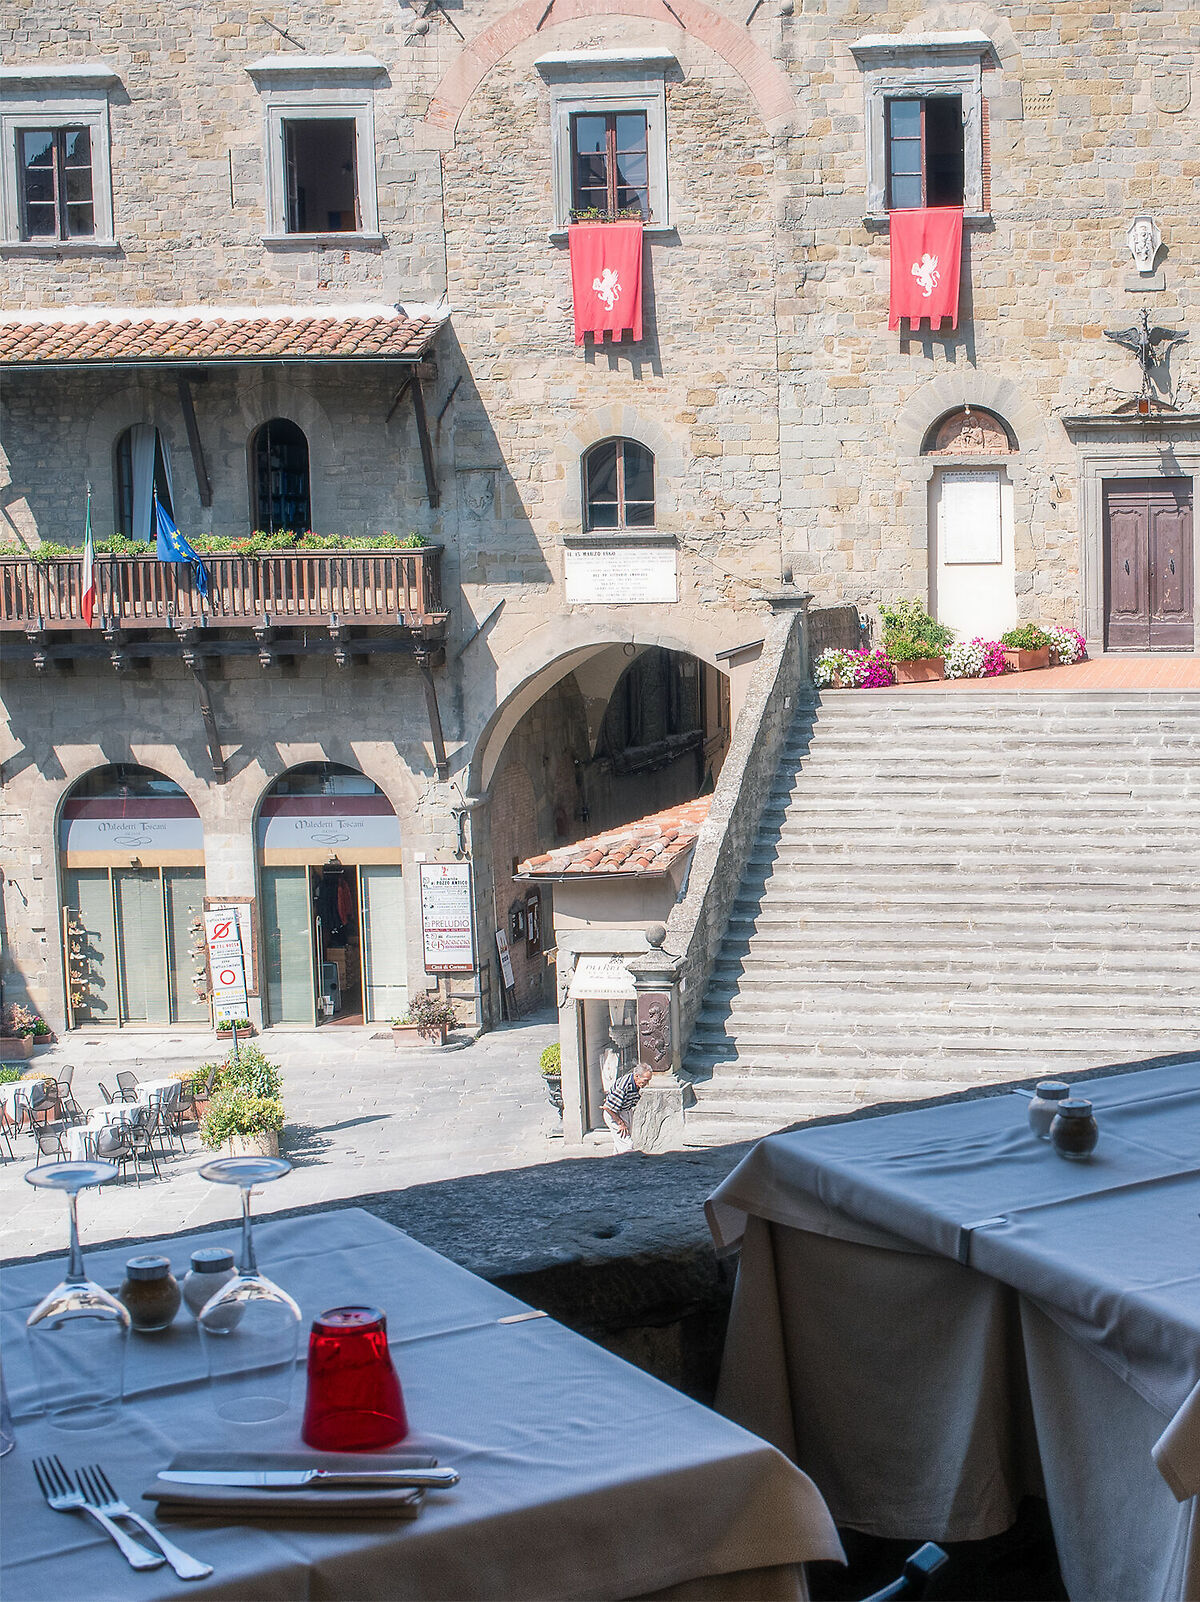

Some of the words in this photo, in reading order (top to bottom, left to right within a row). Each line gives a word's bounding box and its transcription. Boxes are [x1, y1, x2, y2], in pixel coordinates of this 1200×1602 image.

[97, 822, 136, 832] Maledetti
[140, 822, 167, 831] Toscani
[294, 819, 333, 829] Maledetti
[337, 819, 364, 829] Toscani
[431, 919, 470, 928] PRELUDIO
